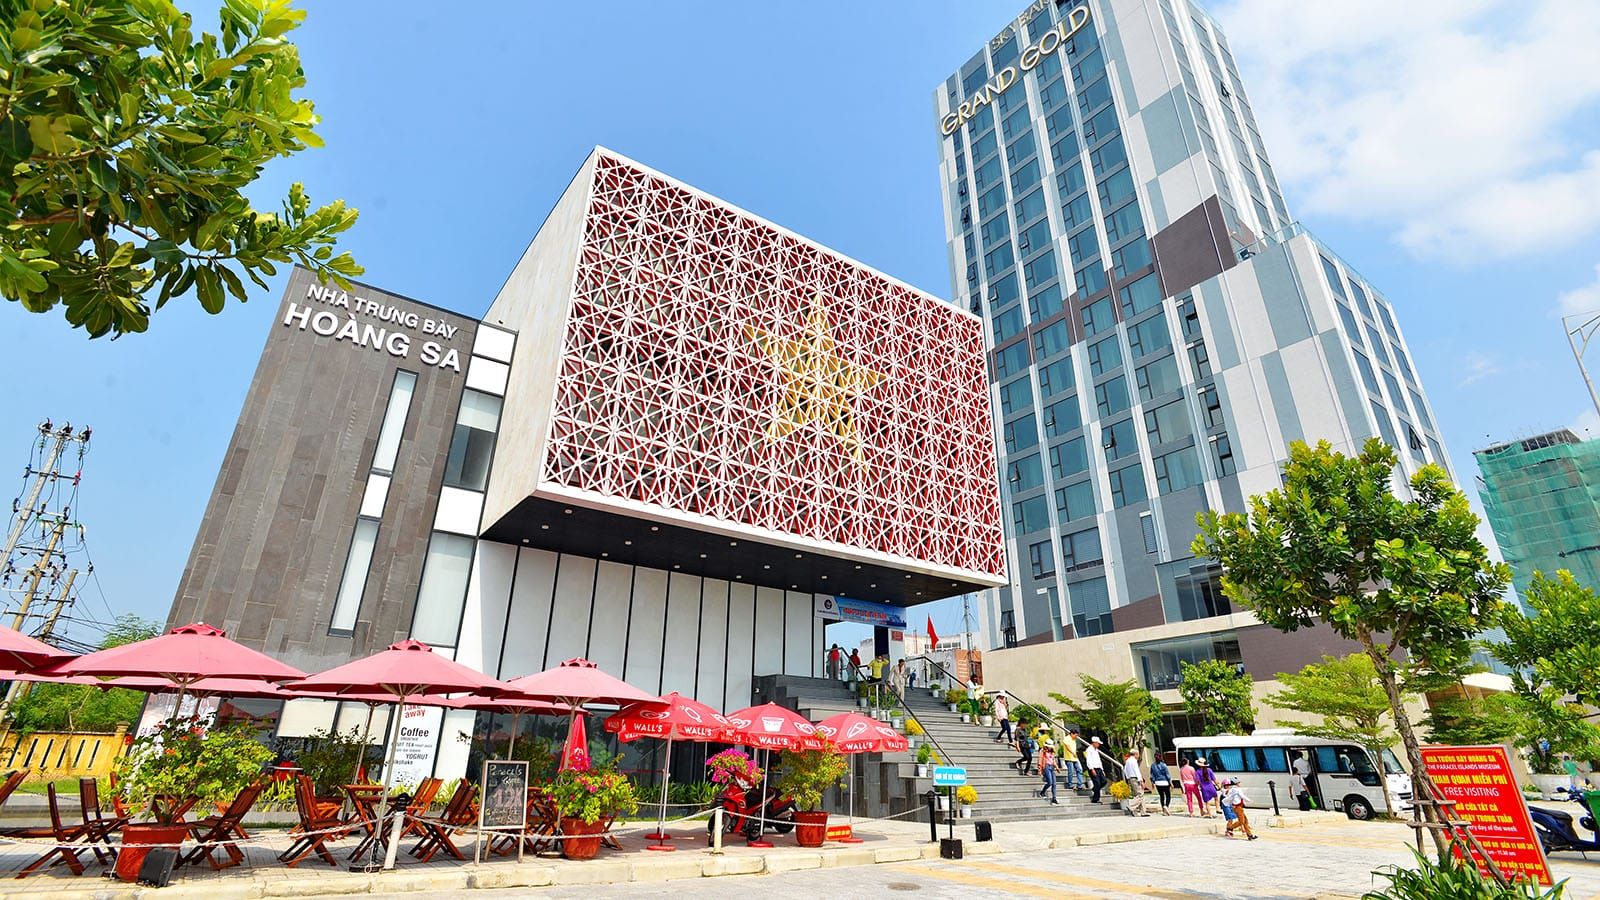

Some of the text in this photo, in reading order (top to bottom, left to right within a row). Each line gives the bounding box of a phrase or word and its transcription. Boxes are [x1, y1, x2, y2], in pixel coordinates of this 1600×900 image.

[991, 22, 1018, 50] SKY
[941, 5, 1090, 136] GRAND GOLD
[307, 283, 458, 340] NHÀ TRƯNG BÀY
[284, 302, 461, 372] HOÀNG SA
[404, 709, 426, 719] away
[400, 726, 429, 737] Coffee
[634, 722, 663, 733] WALL'S
[684, 726, 712, 737] WALL'S
[759, 736, 788, 746] WALL'S
[846, 742, 873, 751] WALL'S
[1451, 775, 1471, 785] QUAN
[1493, 774, 1508, 784] PHÍ
[1444, 787, 1500, 797] FREE VISITING
